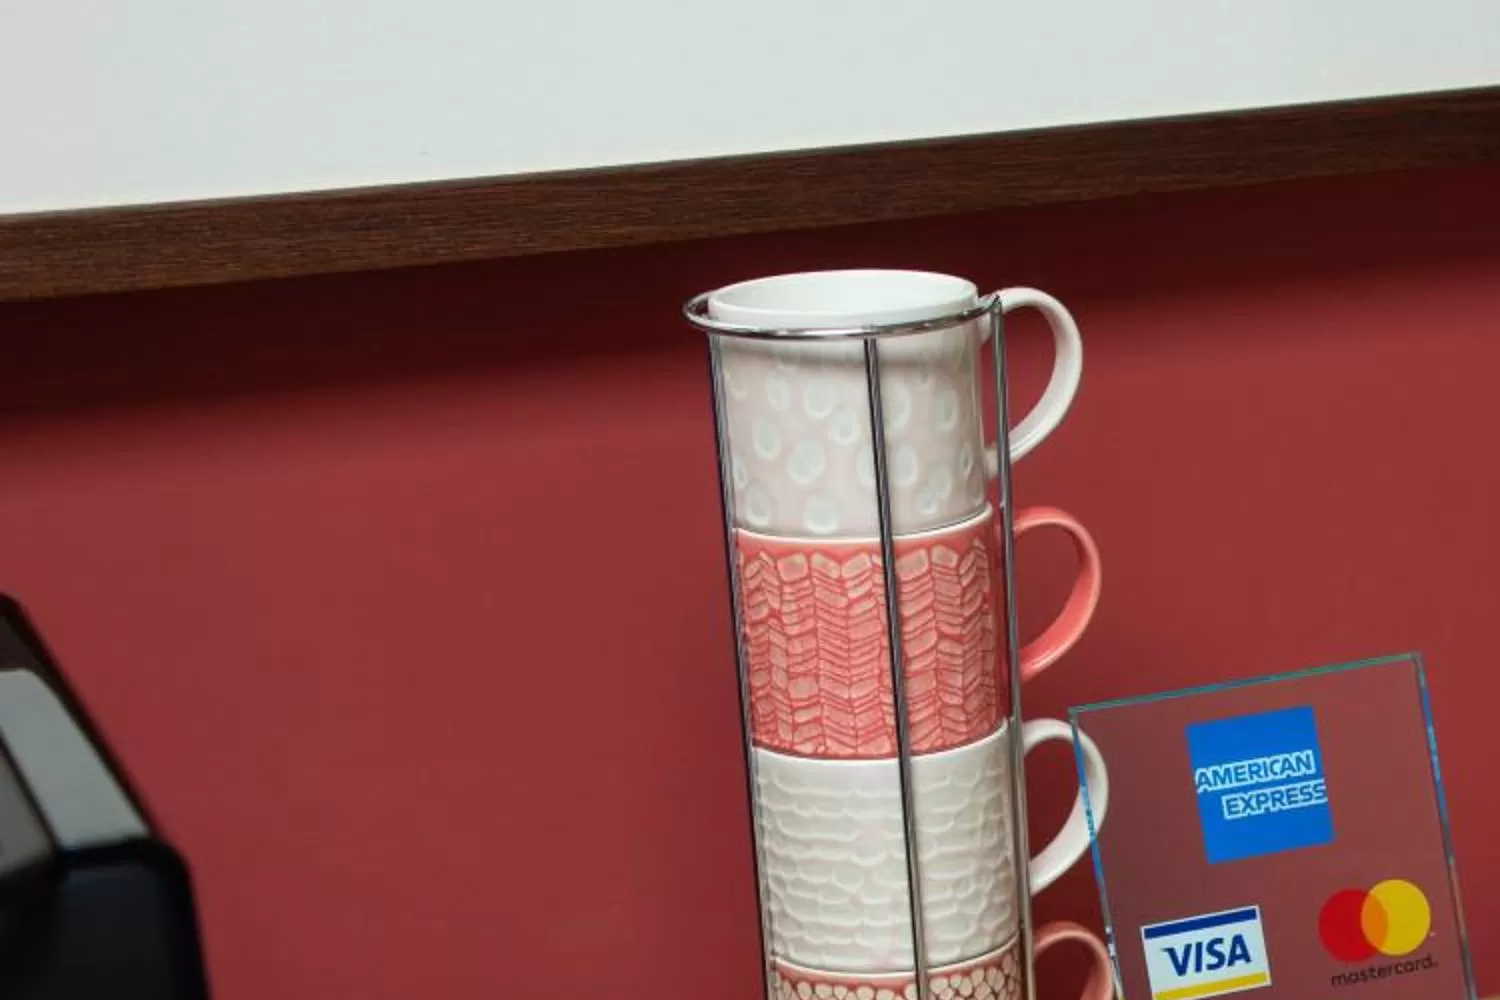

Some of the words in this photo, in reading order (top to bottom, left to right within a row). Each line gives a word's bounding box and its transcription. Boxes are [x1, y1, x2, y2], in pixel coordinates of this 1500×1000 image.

[1194, 750, 1315, 792] AMERICAN
[1221, 779, 1328, 820] EXPRESS
[1164, 934, 1251, 977] VISA
